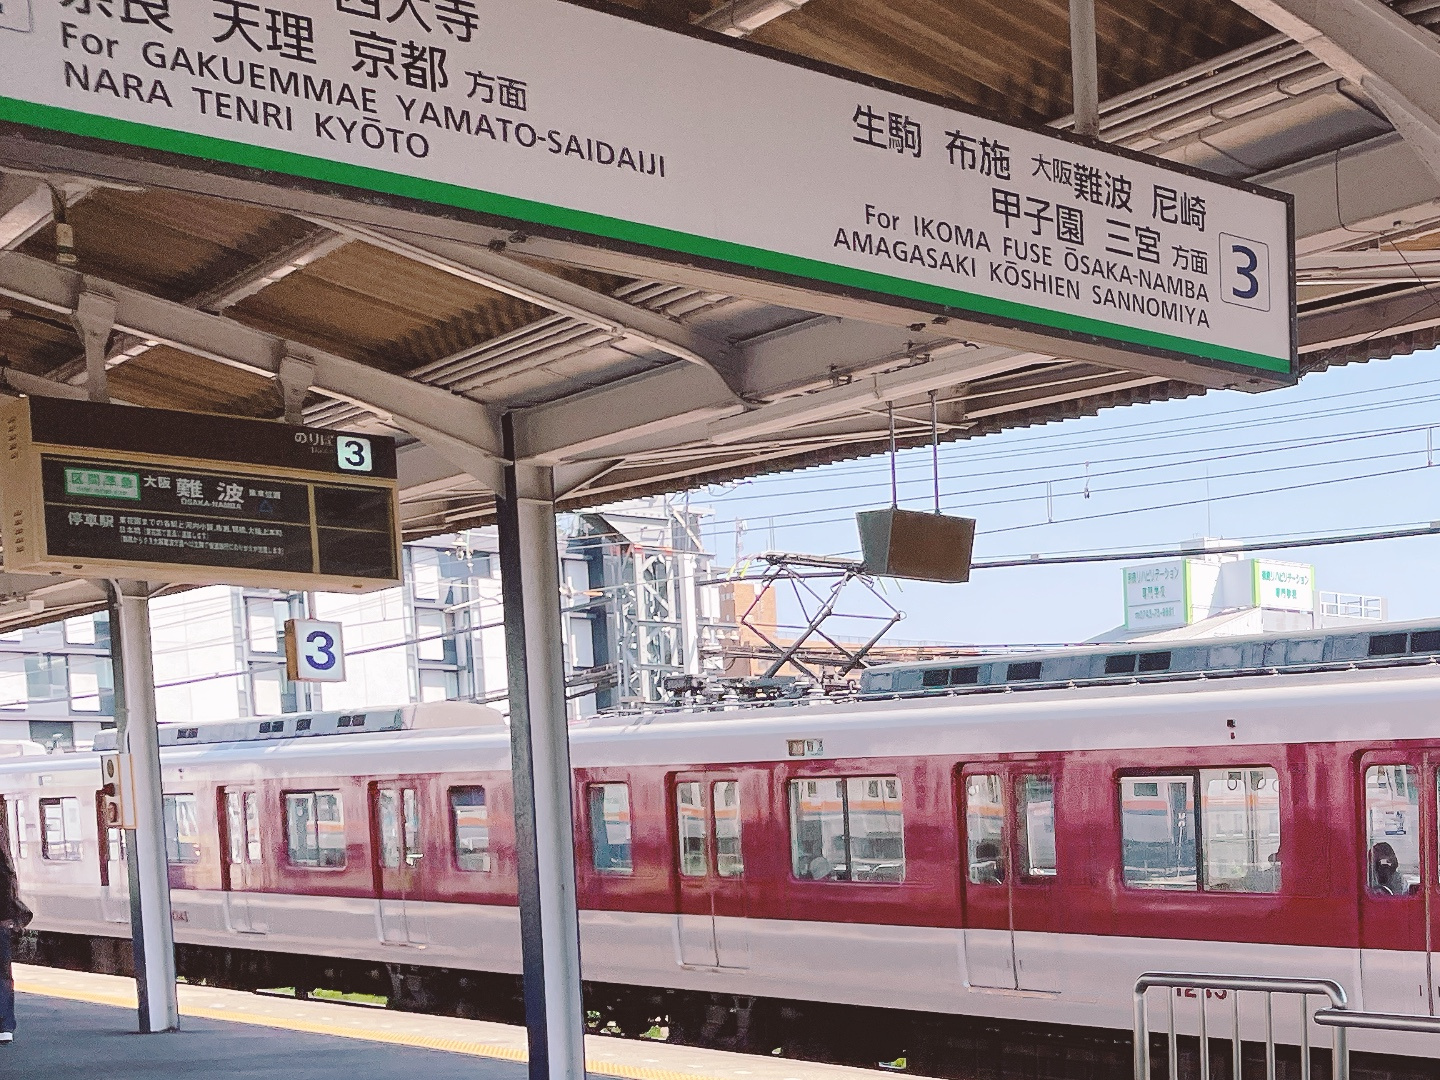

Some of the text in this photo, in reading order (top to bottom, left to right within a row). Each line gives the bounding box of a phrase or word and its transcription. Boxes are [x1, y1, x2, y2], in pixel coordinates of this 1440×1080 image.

[60, 21, 665, 178] For GAKUEMMAE YAMATO-SAIDAIJI
[213, 0, 317, 64] 天理
[349, 29, 449, 92] 京都
[464, 70, 527, 112] 方面
[62, 60, 429, 159] NARA TENRI KYŌTO
[852, 103, 922, 158] 生駒
[944, 129, 1011, 181] 布施
[1152, 184, 1207, 232] 尼崎
[865, 203, 1210, 303] For IKOMA FUSE ŌSAKA-NAMBA
[991, 187, 1208, 275] 甲子園 三宮 方面
[1231, 244, 1259, 299] 3
[833, 227, 1210, 329] AMAGASAKI KŌSHIEN SANNOMIYA
[143, 474, 171, 489] 大阪
[344, 440, 365, 467] 3
[67, 511, 115, 528] 停車駅
[305, 630, 336, 670] 3
